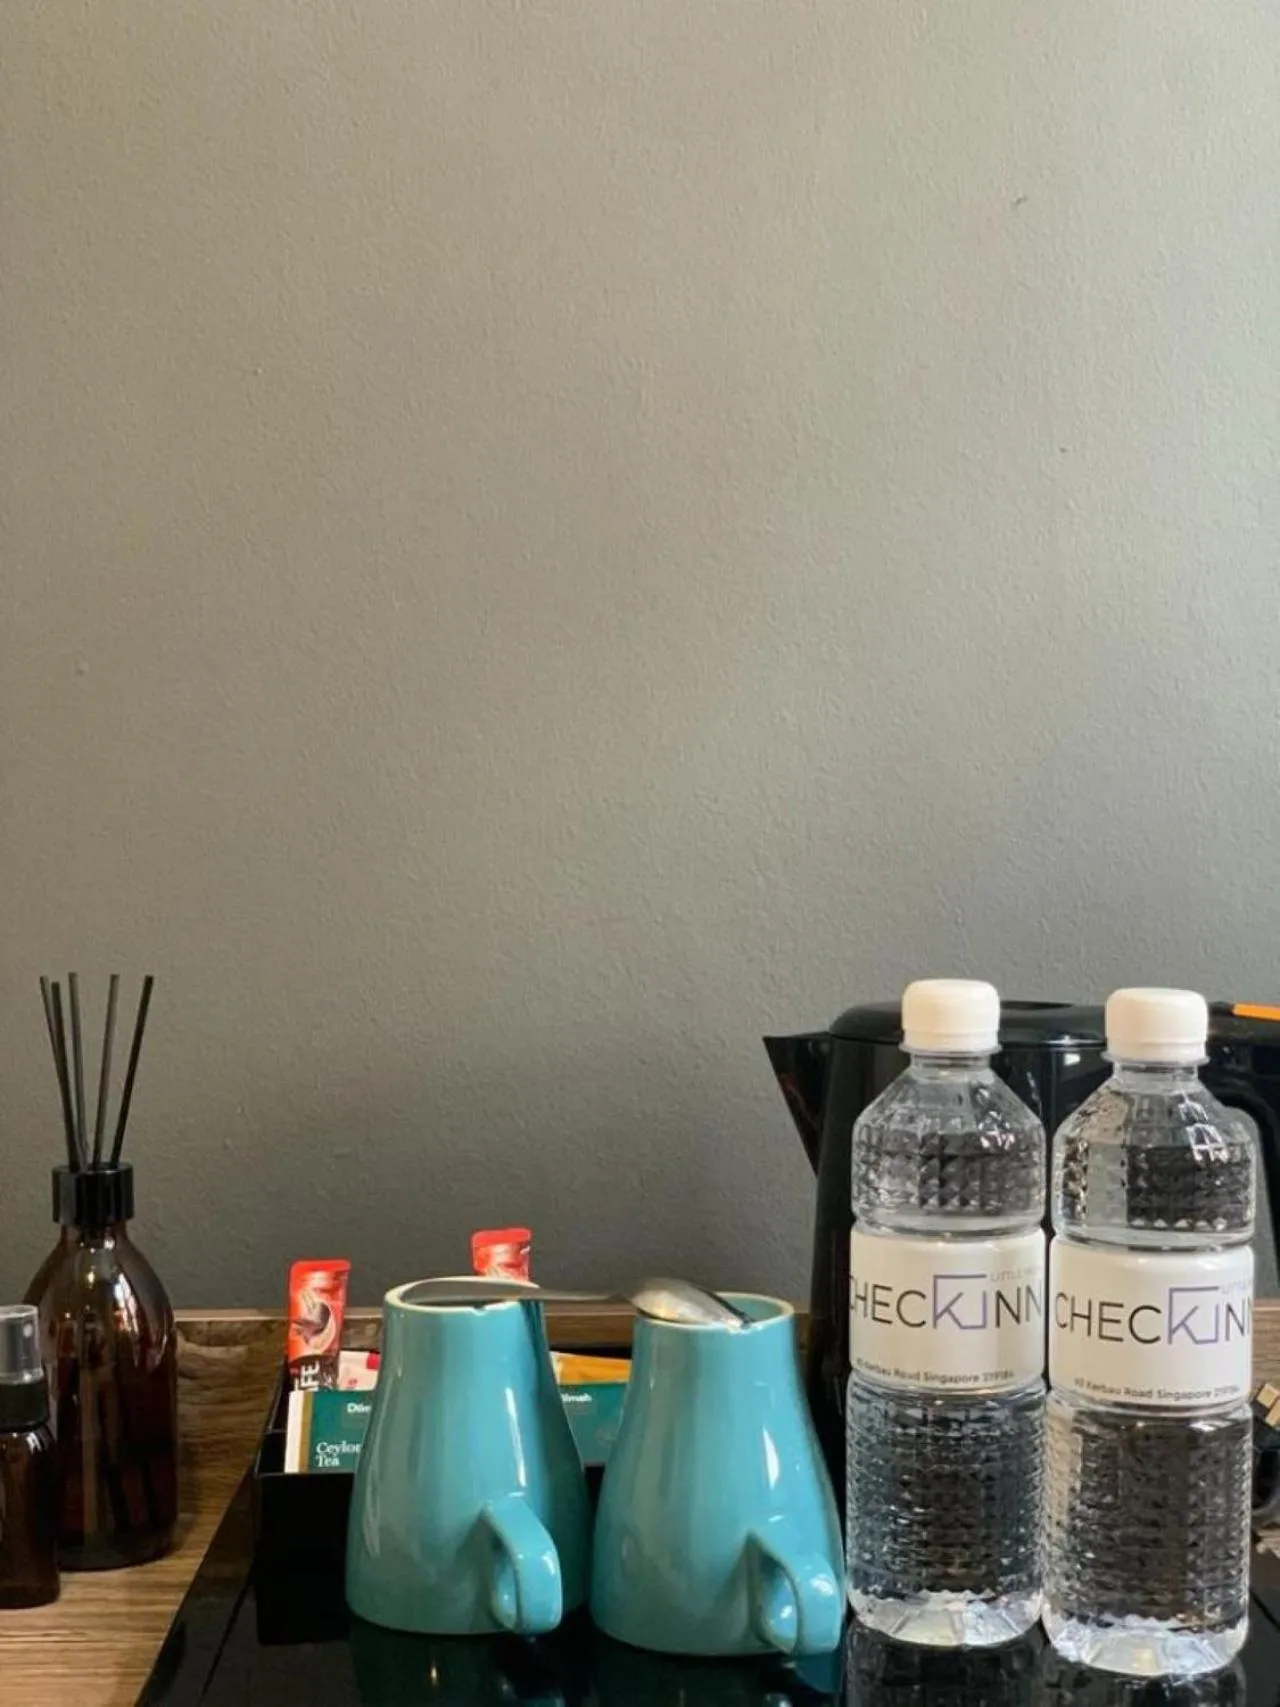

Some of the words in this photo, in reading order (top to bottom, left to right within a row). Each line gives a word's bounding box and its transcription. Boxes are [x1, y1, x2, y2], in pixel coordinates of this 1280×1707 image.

[1056, 1286, 1251, 1345] CHECKIN
[893, 1367, 921, 1381] Road
[923, 1371, 980, 1385] Singapore
[1123, 1386, 1153, 1399] Road
[1155, 1387, 1212, 1402] Singapore
[316, 1455, 340, 1467] Tea
